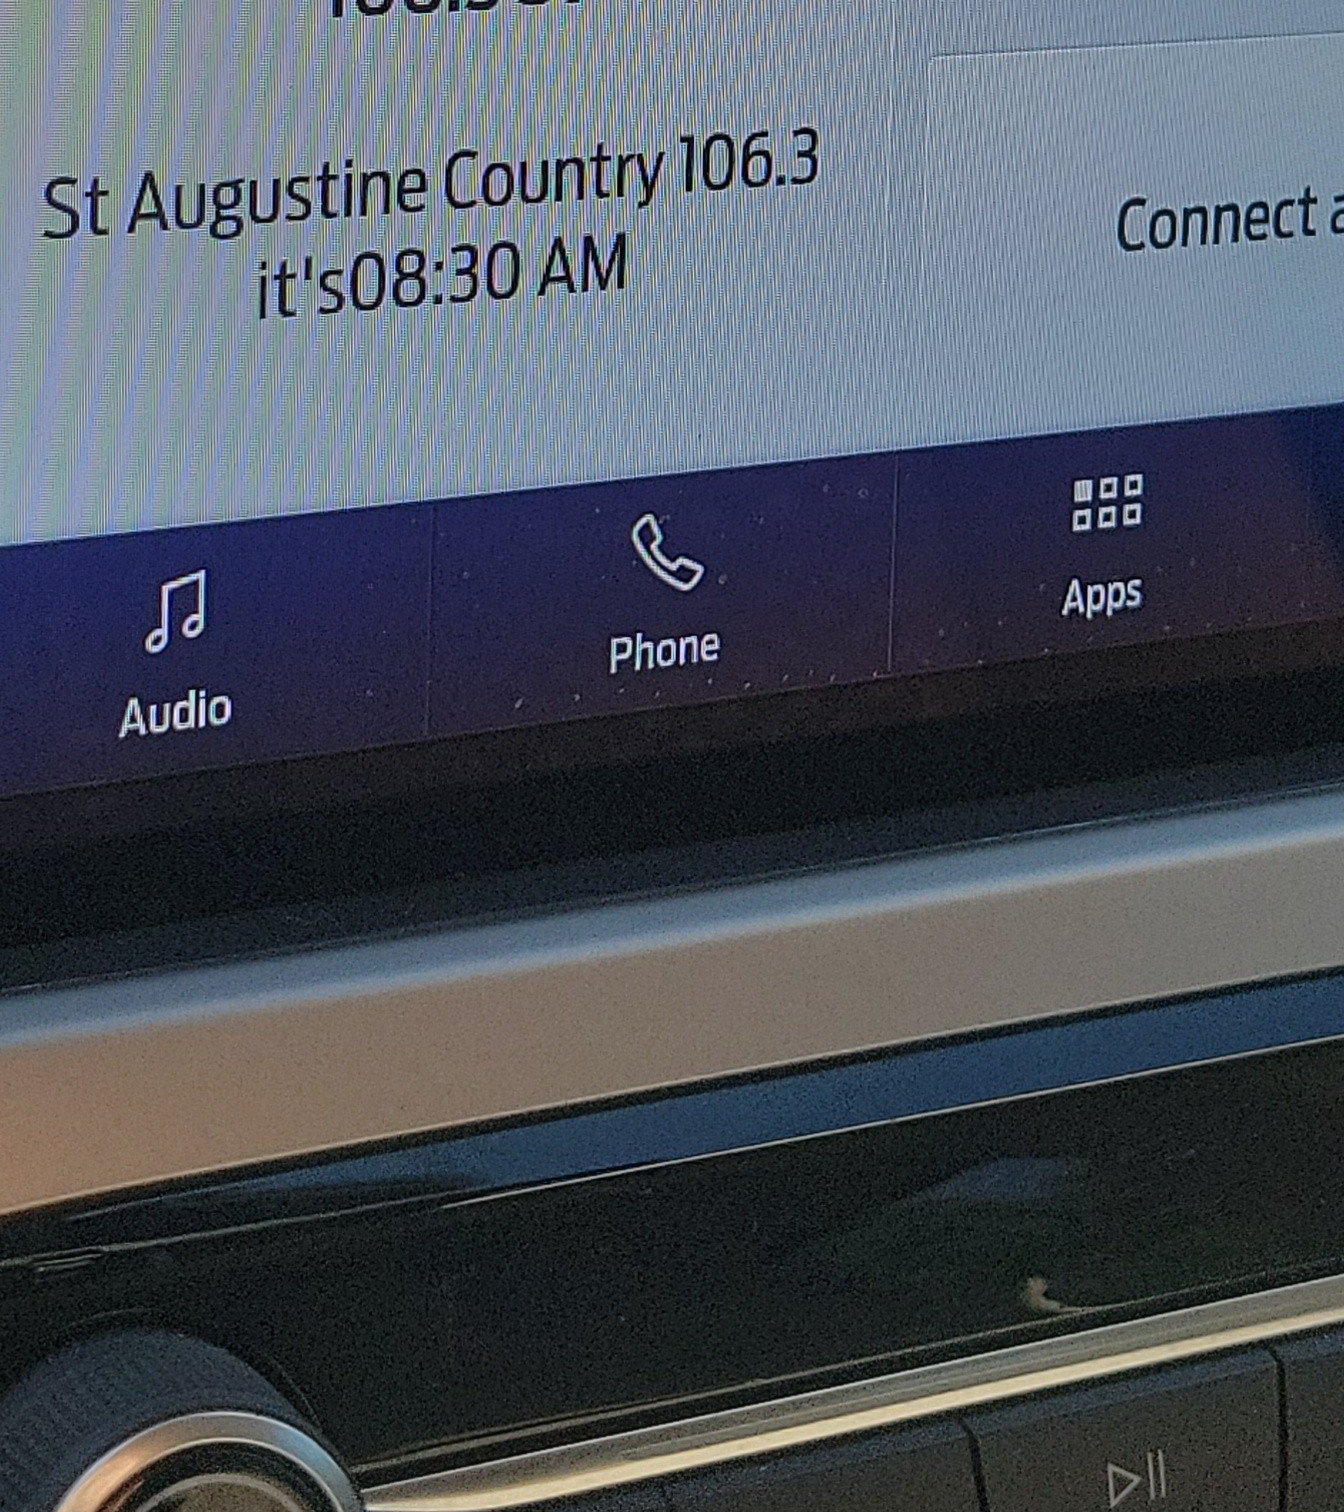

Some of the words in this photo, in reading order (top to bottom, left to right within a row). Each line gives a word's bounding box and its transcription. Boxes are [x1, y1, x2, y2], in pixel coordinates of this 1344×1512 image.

[42, 175, 111, 240] St
[126, 159, 428, 240] Augustine
[444, 141, 666, 210] Country
[679, 126, 820, 194] 106.3
[1115, 184, 1319, 253] Connect
[537, 231, 628, 297] AM
[1061, 577, 1144, 621] Apps
[609, 632, 721, 675] Phone
[118, 688, 233, 739] Audio
